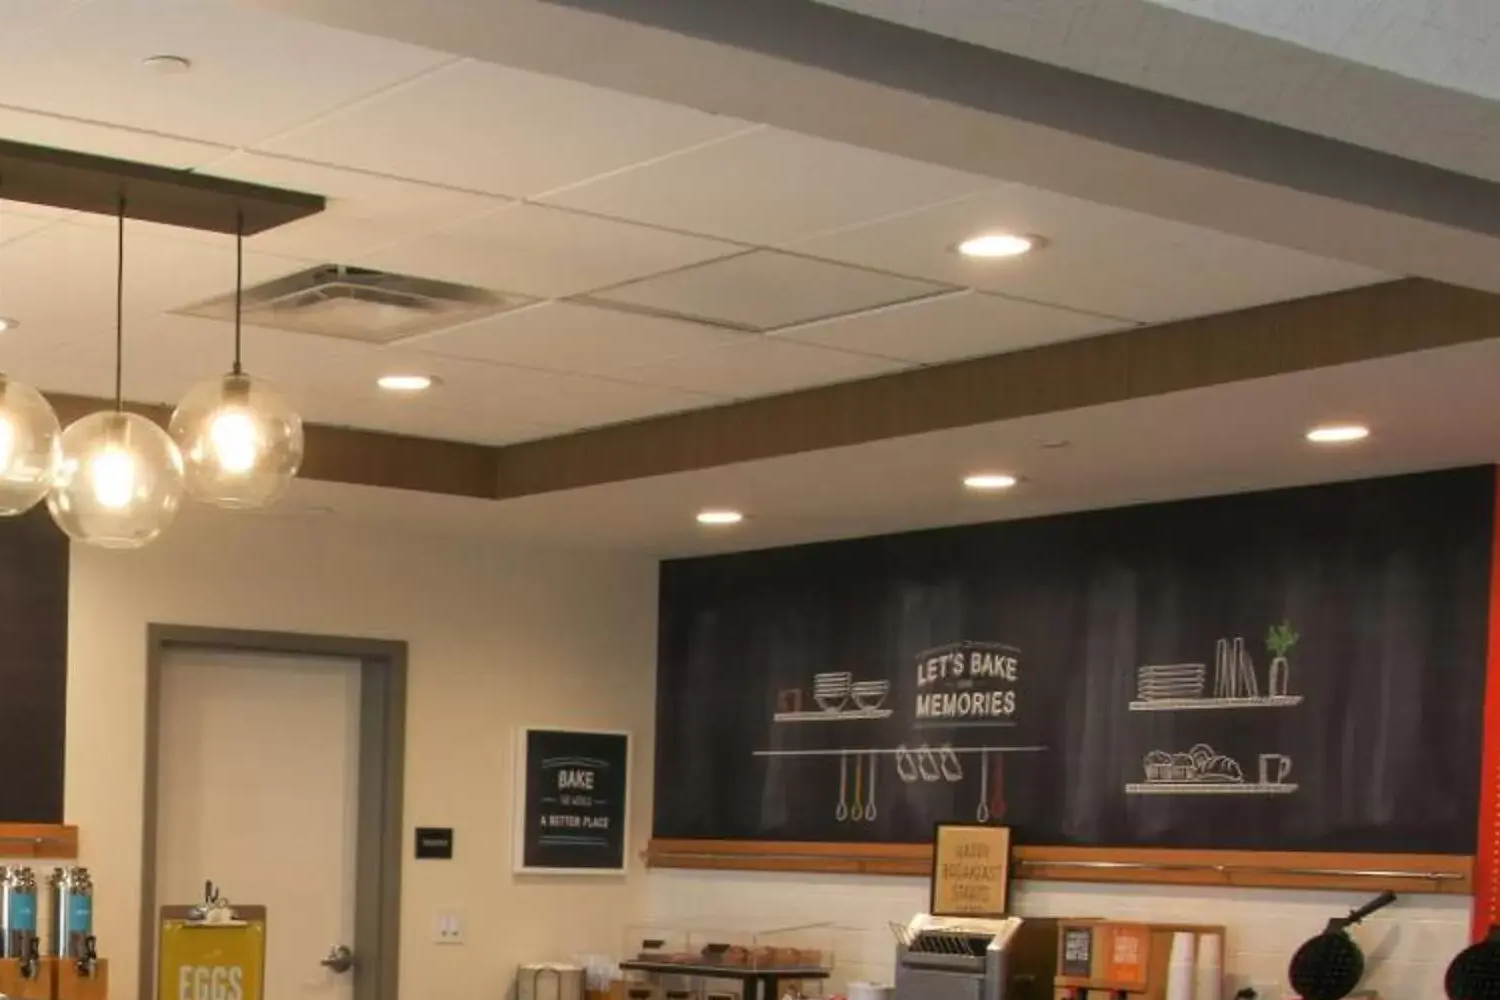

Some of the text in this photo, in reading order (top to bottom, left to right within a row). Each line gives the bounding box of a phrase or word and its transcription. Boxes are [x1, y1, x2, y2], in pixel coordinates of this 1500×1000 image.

[917, 651, 1019, 687] LET'S BAKE
[916, 690, 1017, 718] MEMORIES
[558, 769, 595, 790] BAKE
[540, 815, 547, 826] A
